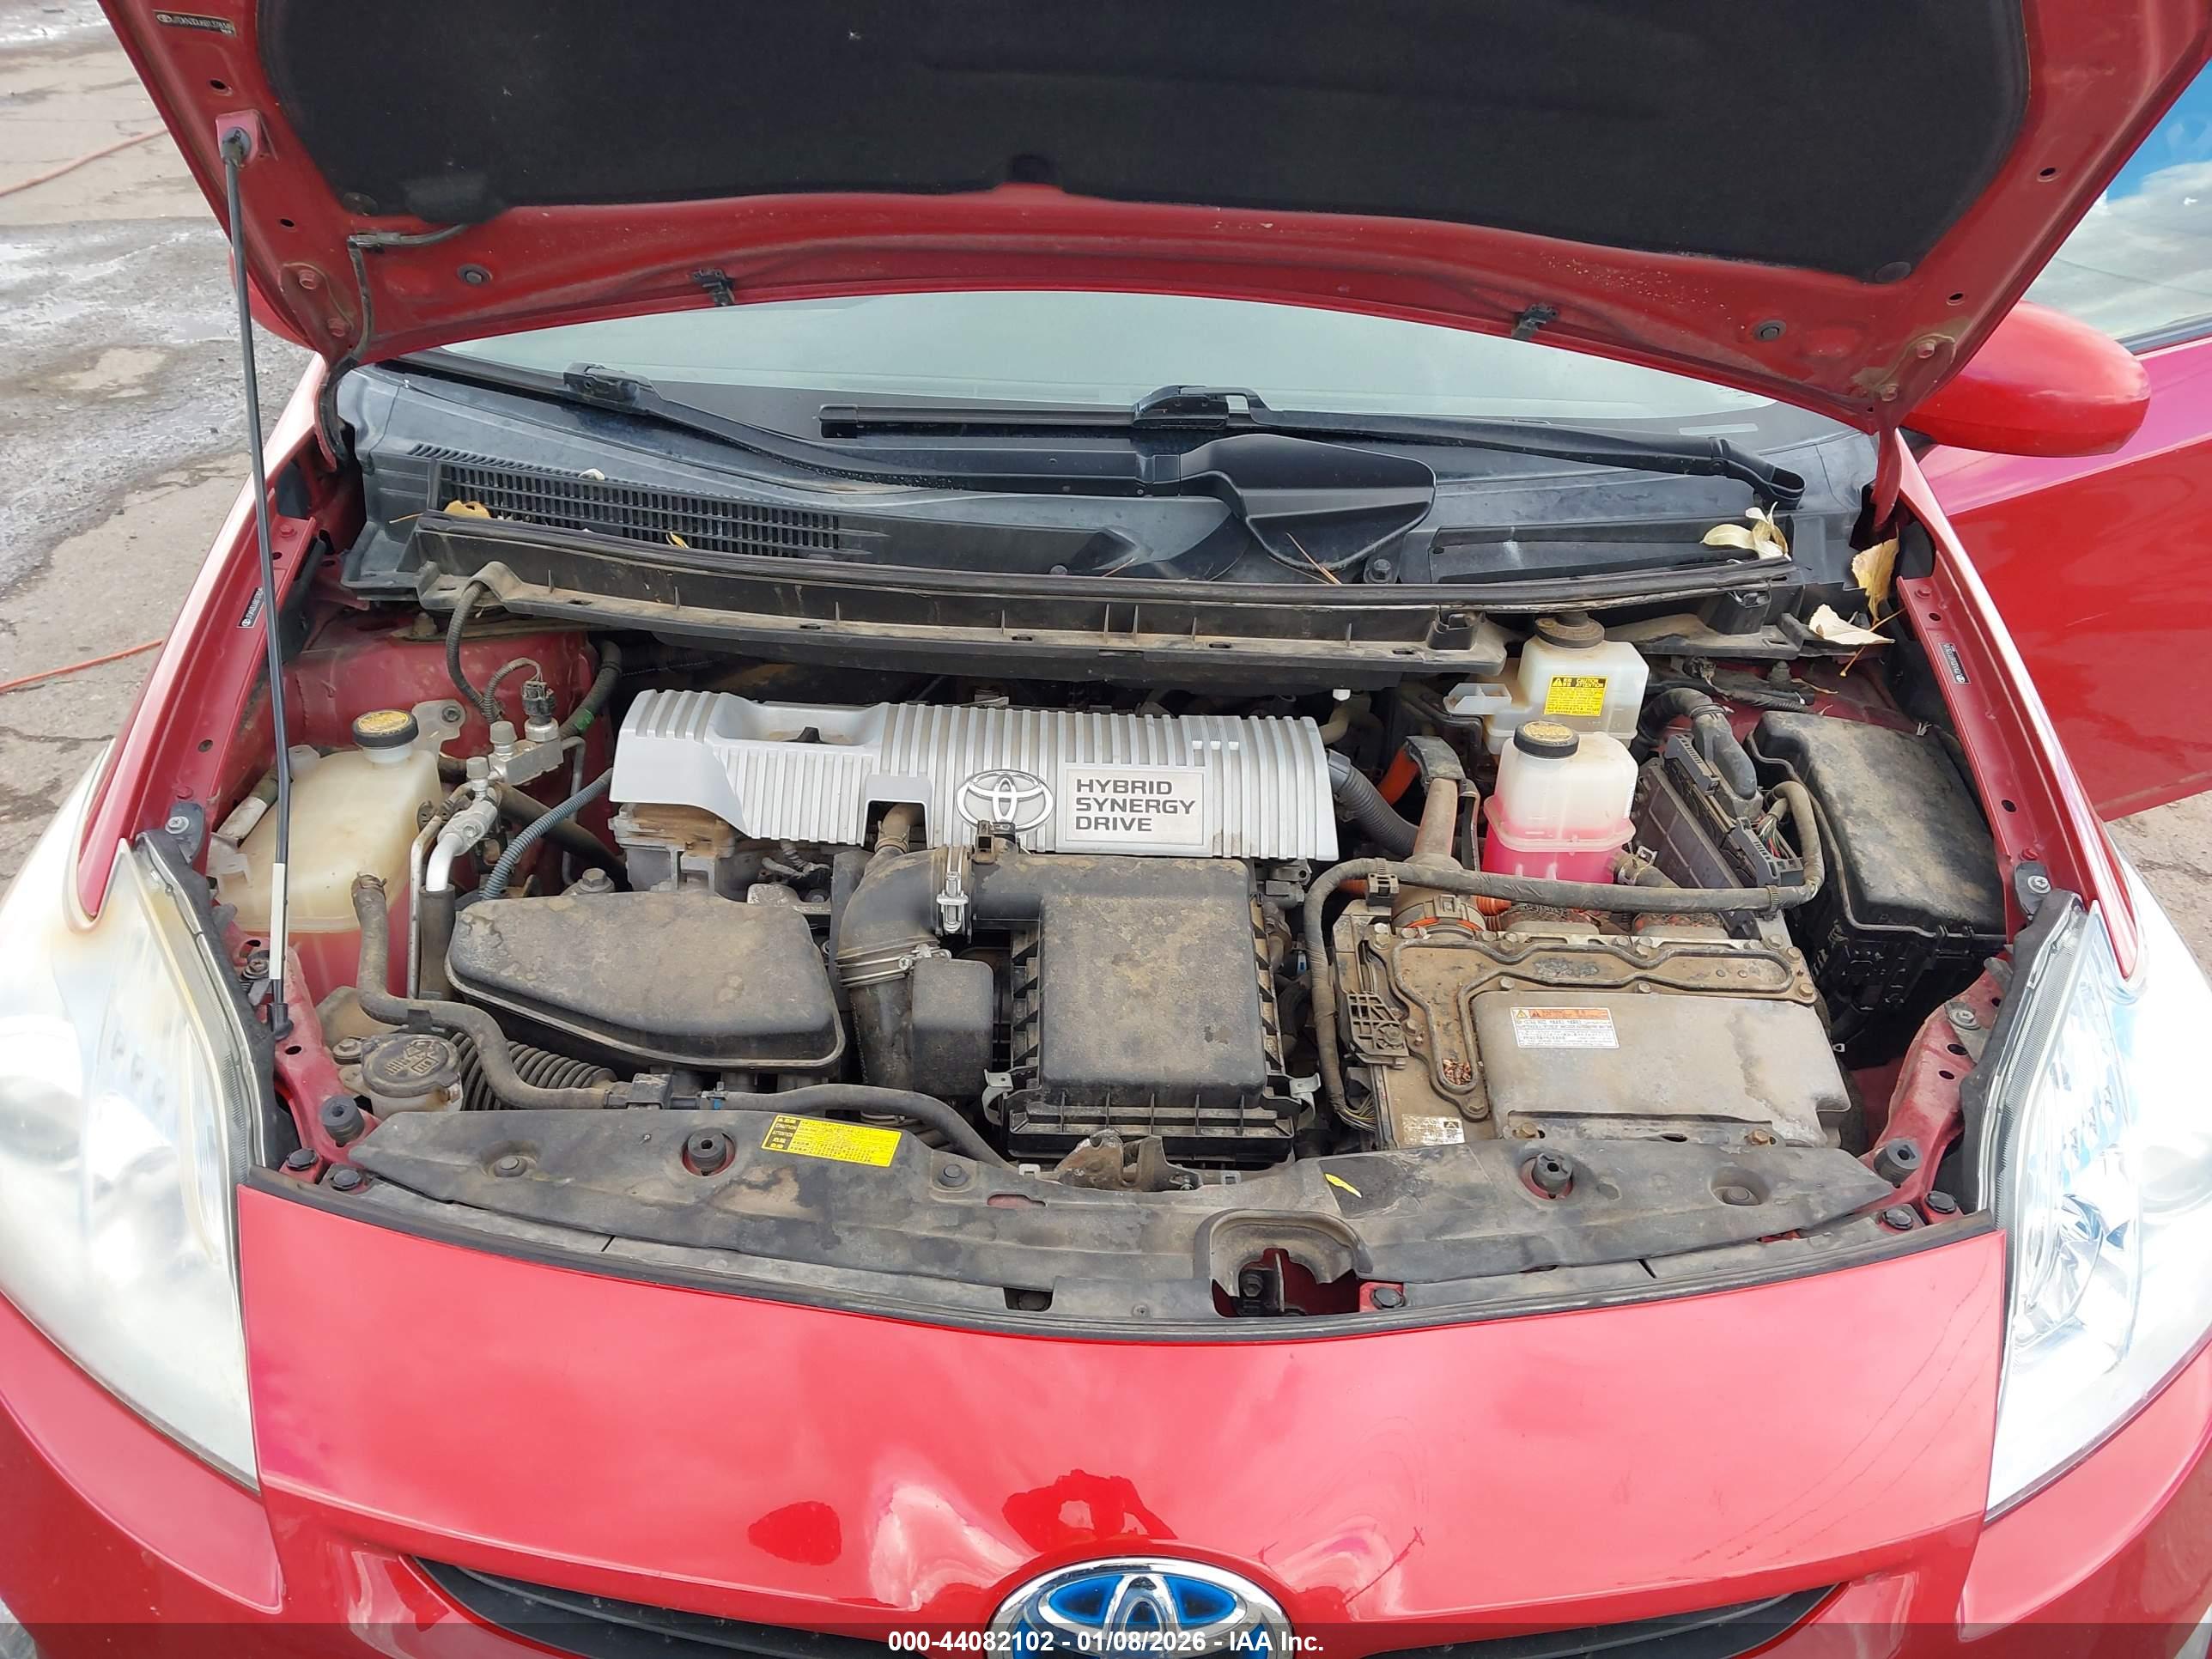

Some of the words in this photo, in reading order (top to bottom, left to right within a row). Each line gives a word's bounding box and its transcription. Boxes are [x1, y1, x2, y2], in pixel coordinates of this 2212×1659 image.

[1076, 778, 1173, 795] HYBRID
[1076, 797, 1196, 815] SYNERGY
[1075, 816, 1152, 832] DRIVE
